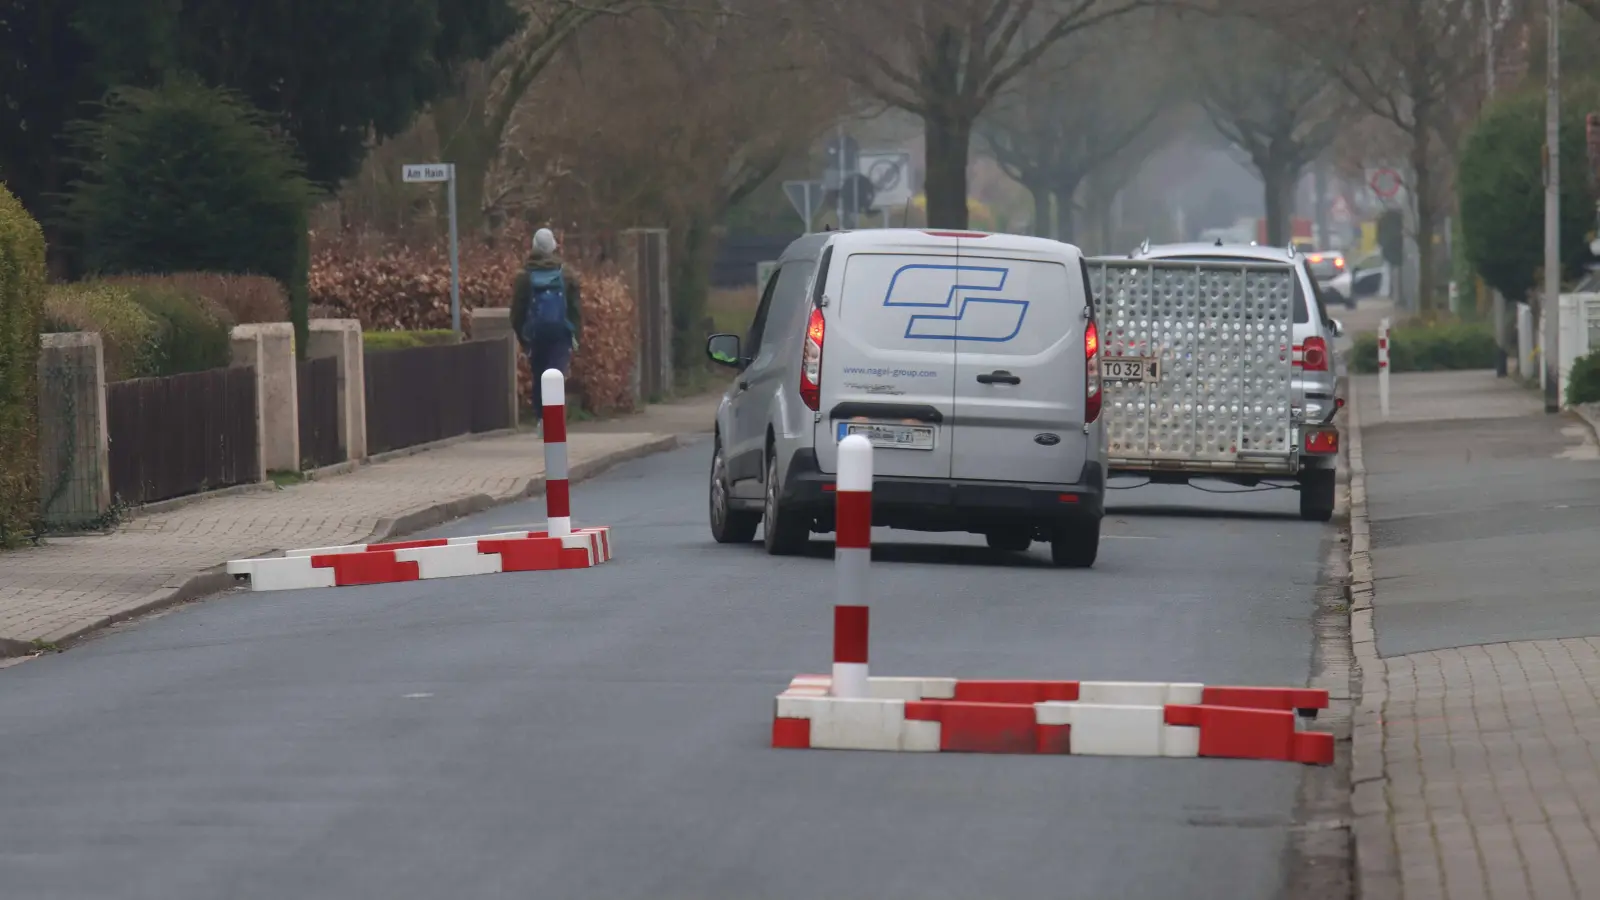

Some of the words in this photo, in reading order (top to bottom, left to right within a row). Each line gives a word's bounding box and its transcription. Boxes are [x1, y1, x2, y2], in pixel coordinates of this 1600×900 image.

[407, 168, 421, 178] Am
[424, 167, 445, 178] Hain
[843, 366, 937, 378] www.nagel-group.com
[1124, 363, 1141, 377] 32
